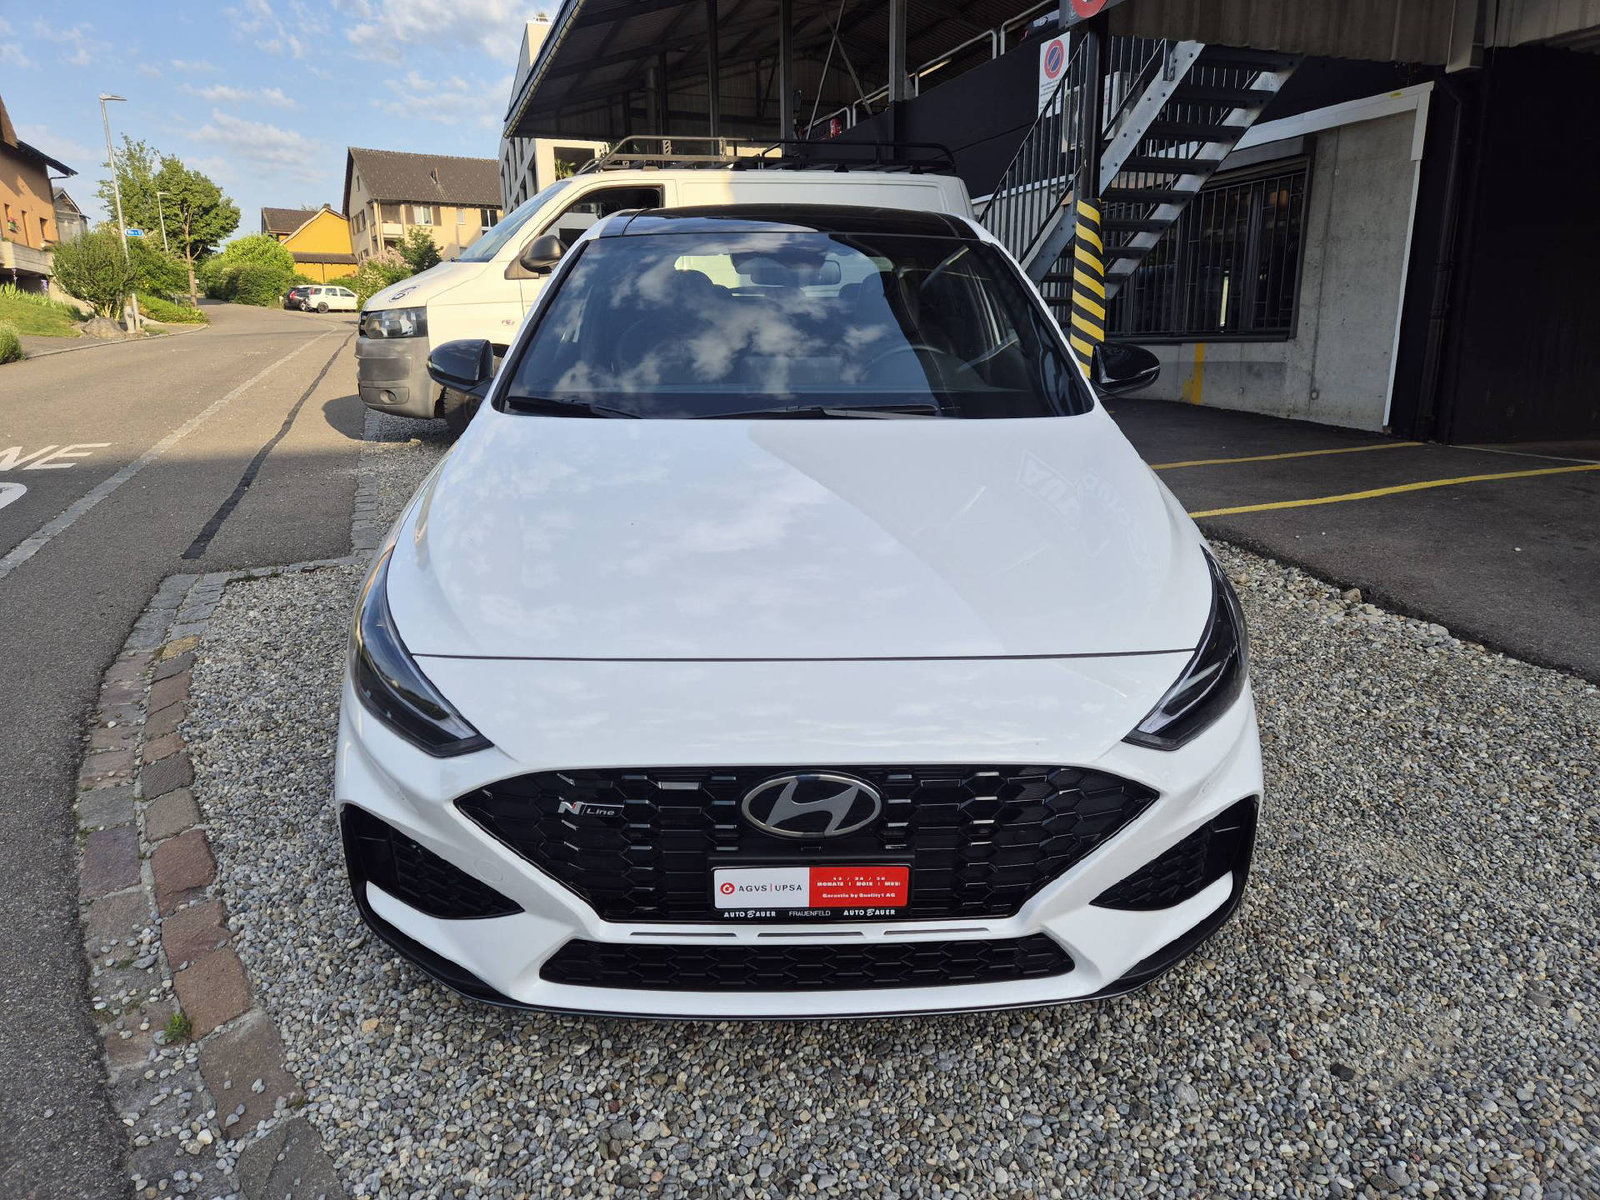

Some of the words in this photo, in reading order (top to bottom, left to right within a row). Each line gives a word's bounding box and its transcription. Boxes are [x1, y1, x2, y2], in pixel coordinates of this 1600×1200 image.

[557, 801, 583, 815] N
[586, 808, 615, 816] Line
[774, 884, 803, 892] UPSA
